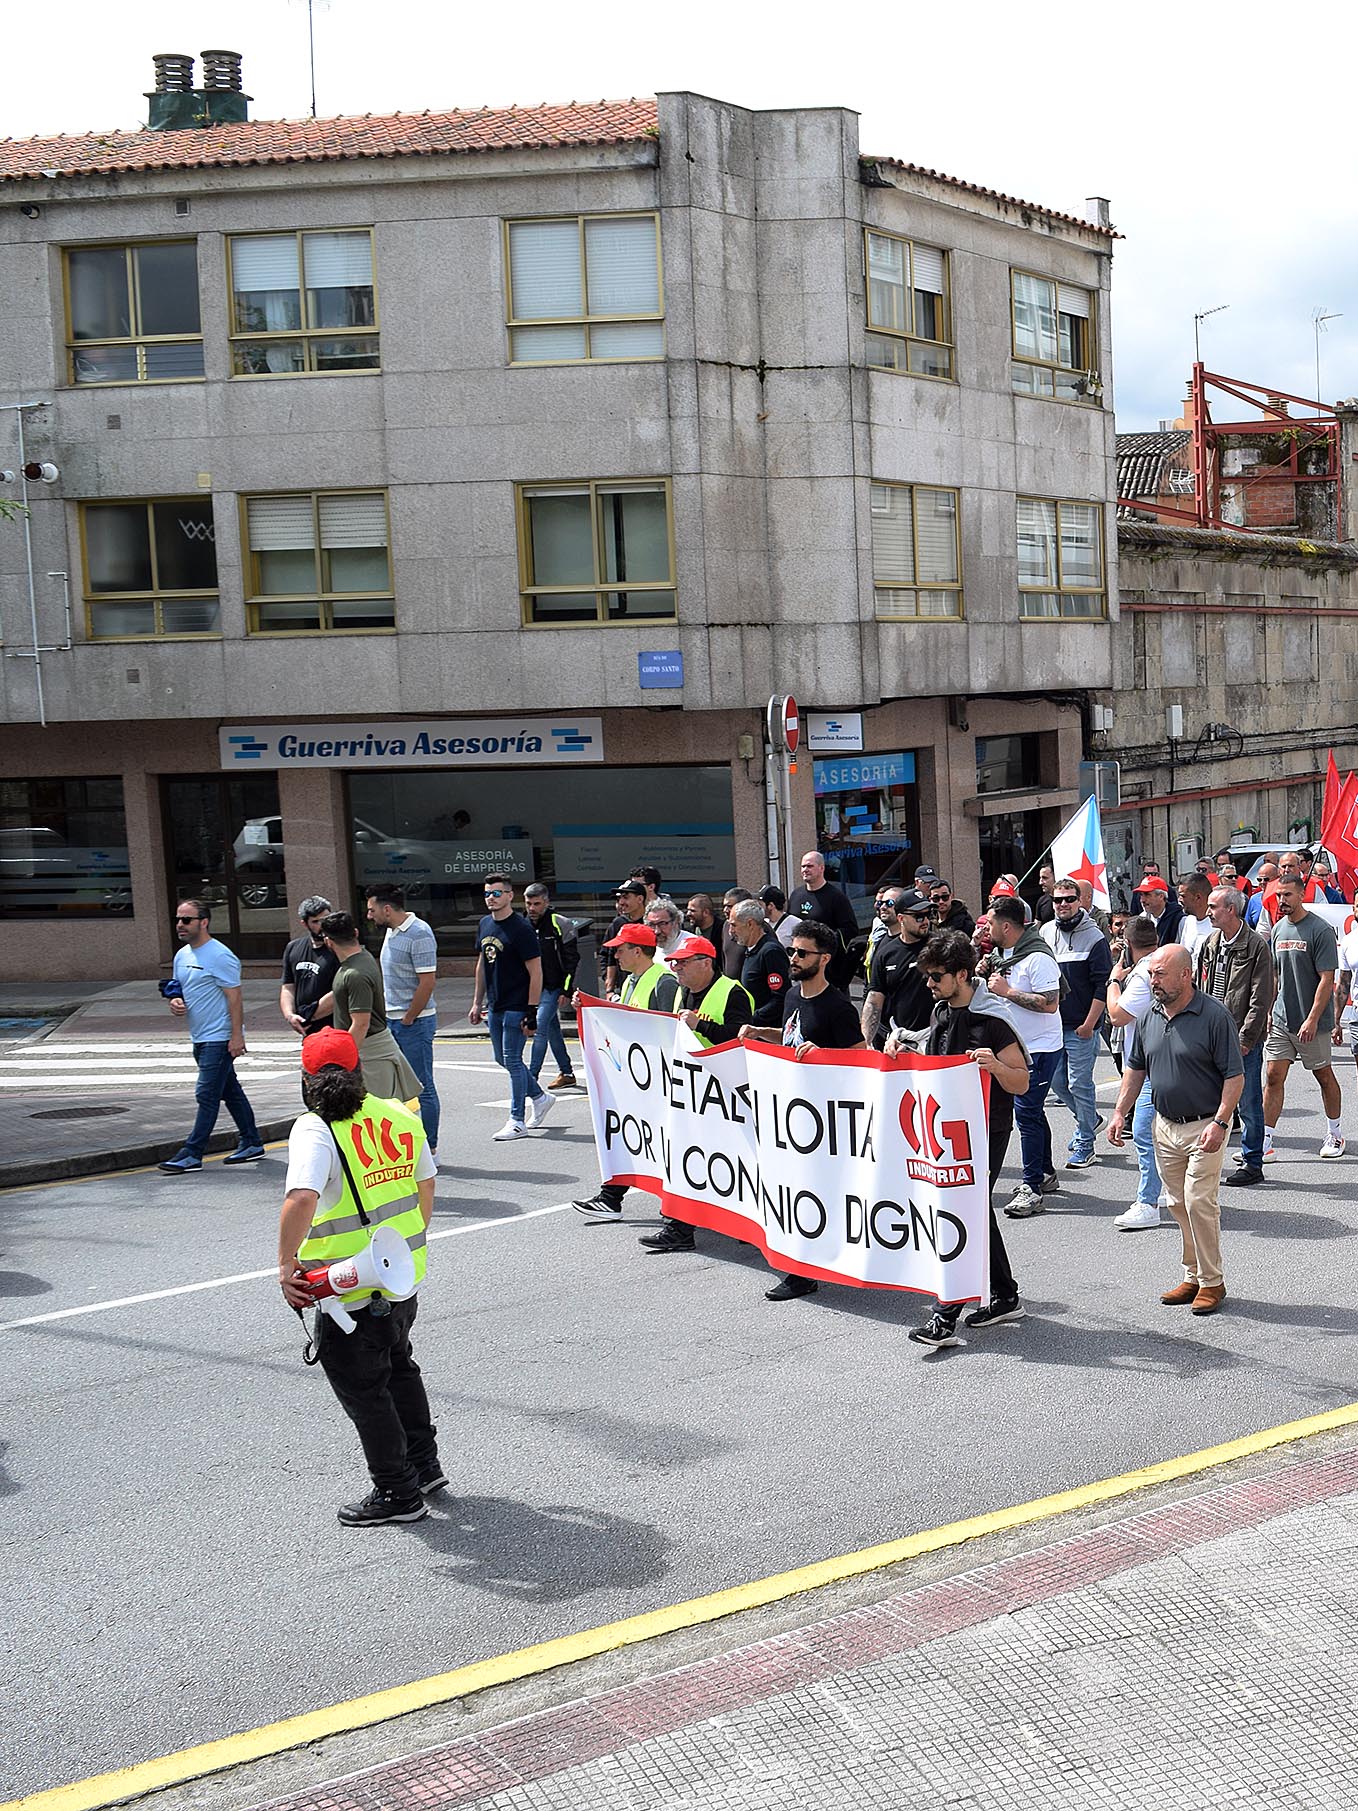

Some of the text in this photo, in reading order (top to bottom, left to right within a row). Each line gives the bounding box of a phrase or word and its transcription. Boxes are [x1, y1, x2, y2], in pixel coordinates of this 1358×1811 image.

[278, 730, 543, 758] Guerriva Asesoría
[819, 761, 897, 785] ASESORÍA
[445, 862, 526, 873] DE EMPRESAS
[455, 849, 513, 861] ASESORÍA
[628, 1042, 651, 1091] O
[772, 1093, 876, 1163] LOITA
[899, 1089, 973, 1161] CIG
[364, 1165, 413, 1188] INDUTRI
[605, 1109, 657, 1163] POR
[682, 1145, 827, 1240] CONNIO
[845, 1193, 968, 1263] DIGNO
